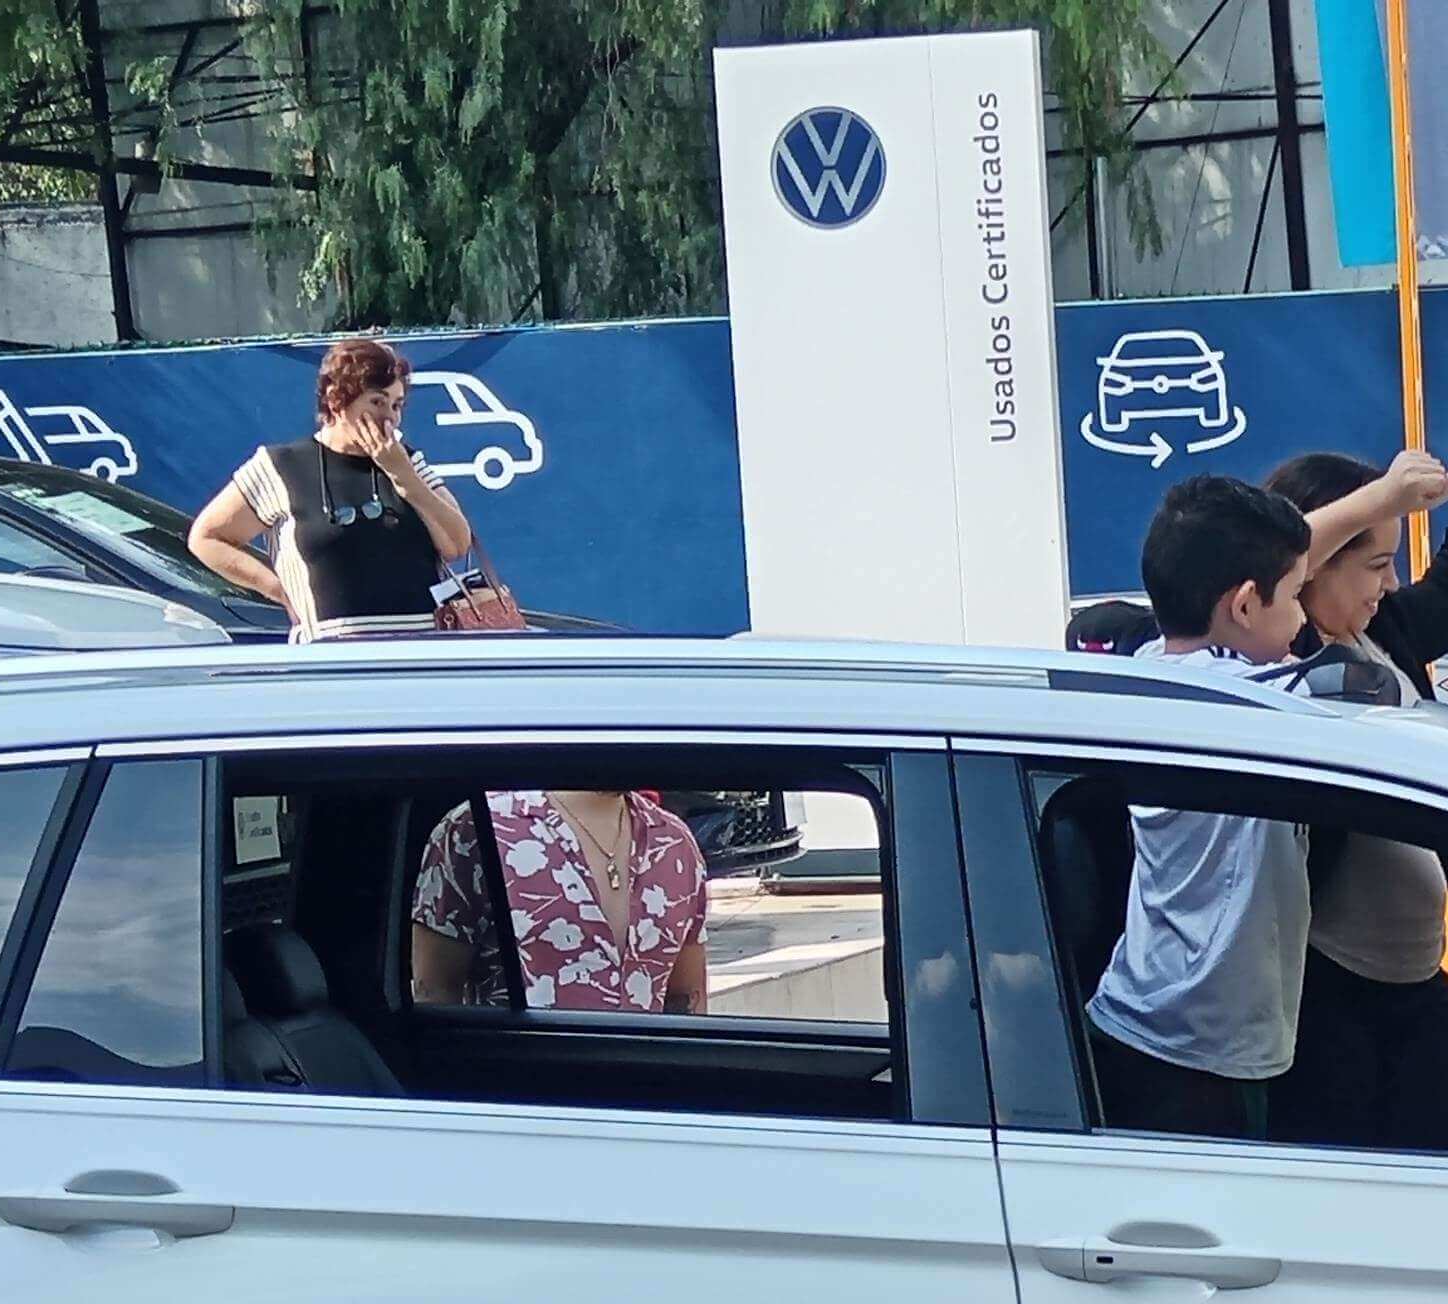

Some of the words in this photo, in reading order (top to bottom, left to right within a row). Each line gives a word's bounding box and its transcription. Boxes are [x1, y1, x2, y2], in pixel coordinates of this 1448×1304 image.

[771, 106, 886, 229] VW
[973, 91, 1009, 304] Certificados
[986, 316, 1017, 443] Usados
